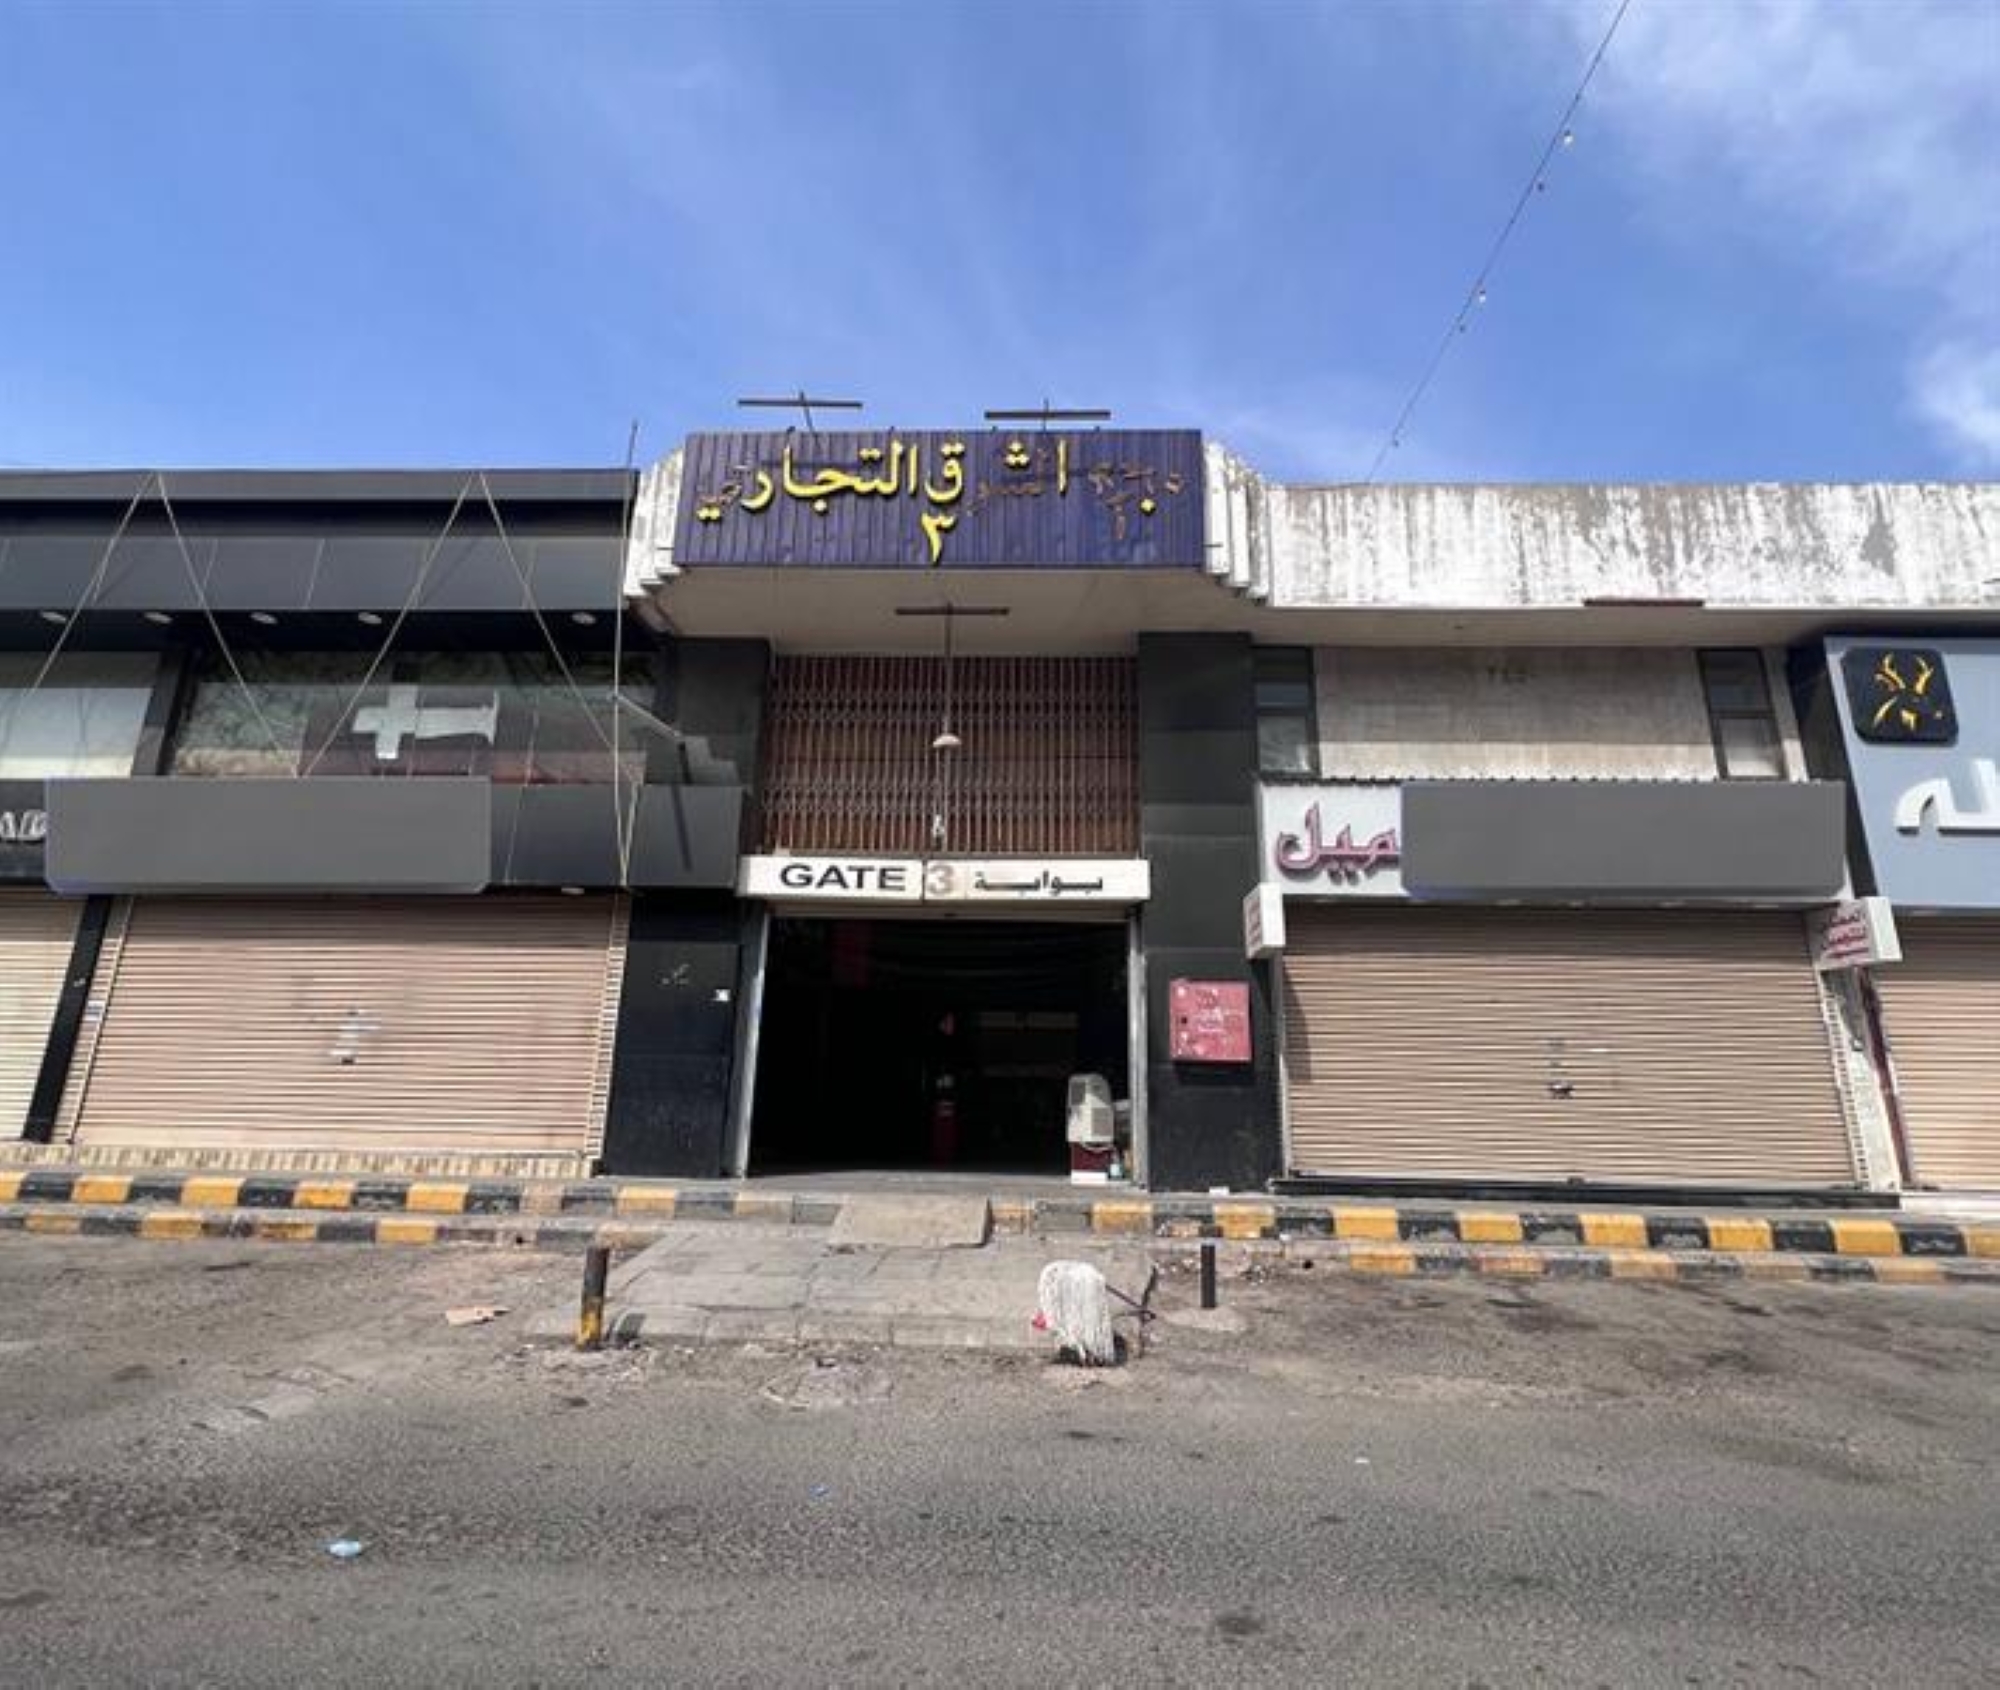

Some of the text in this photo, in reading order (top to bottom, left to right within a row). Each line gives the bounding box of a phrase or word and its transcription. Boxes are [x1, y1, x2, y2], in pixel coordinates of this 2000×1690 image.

[920, 509, 958, 566] ٣
[779, 863, 953, 896] GATE 3
[974, 869, 1103, 895] بوابة
